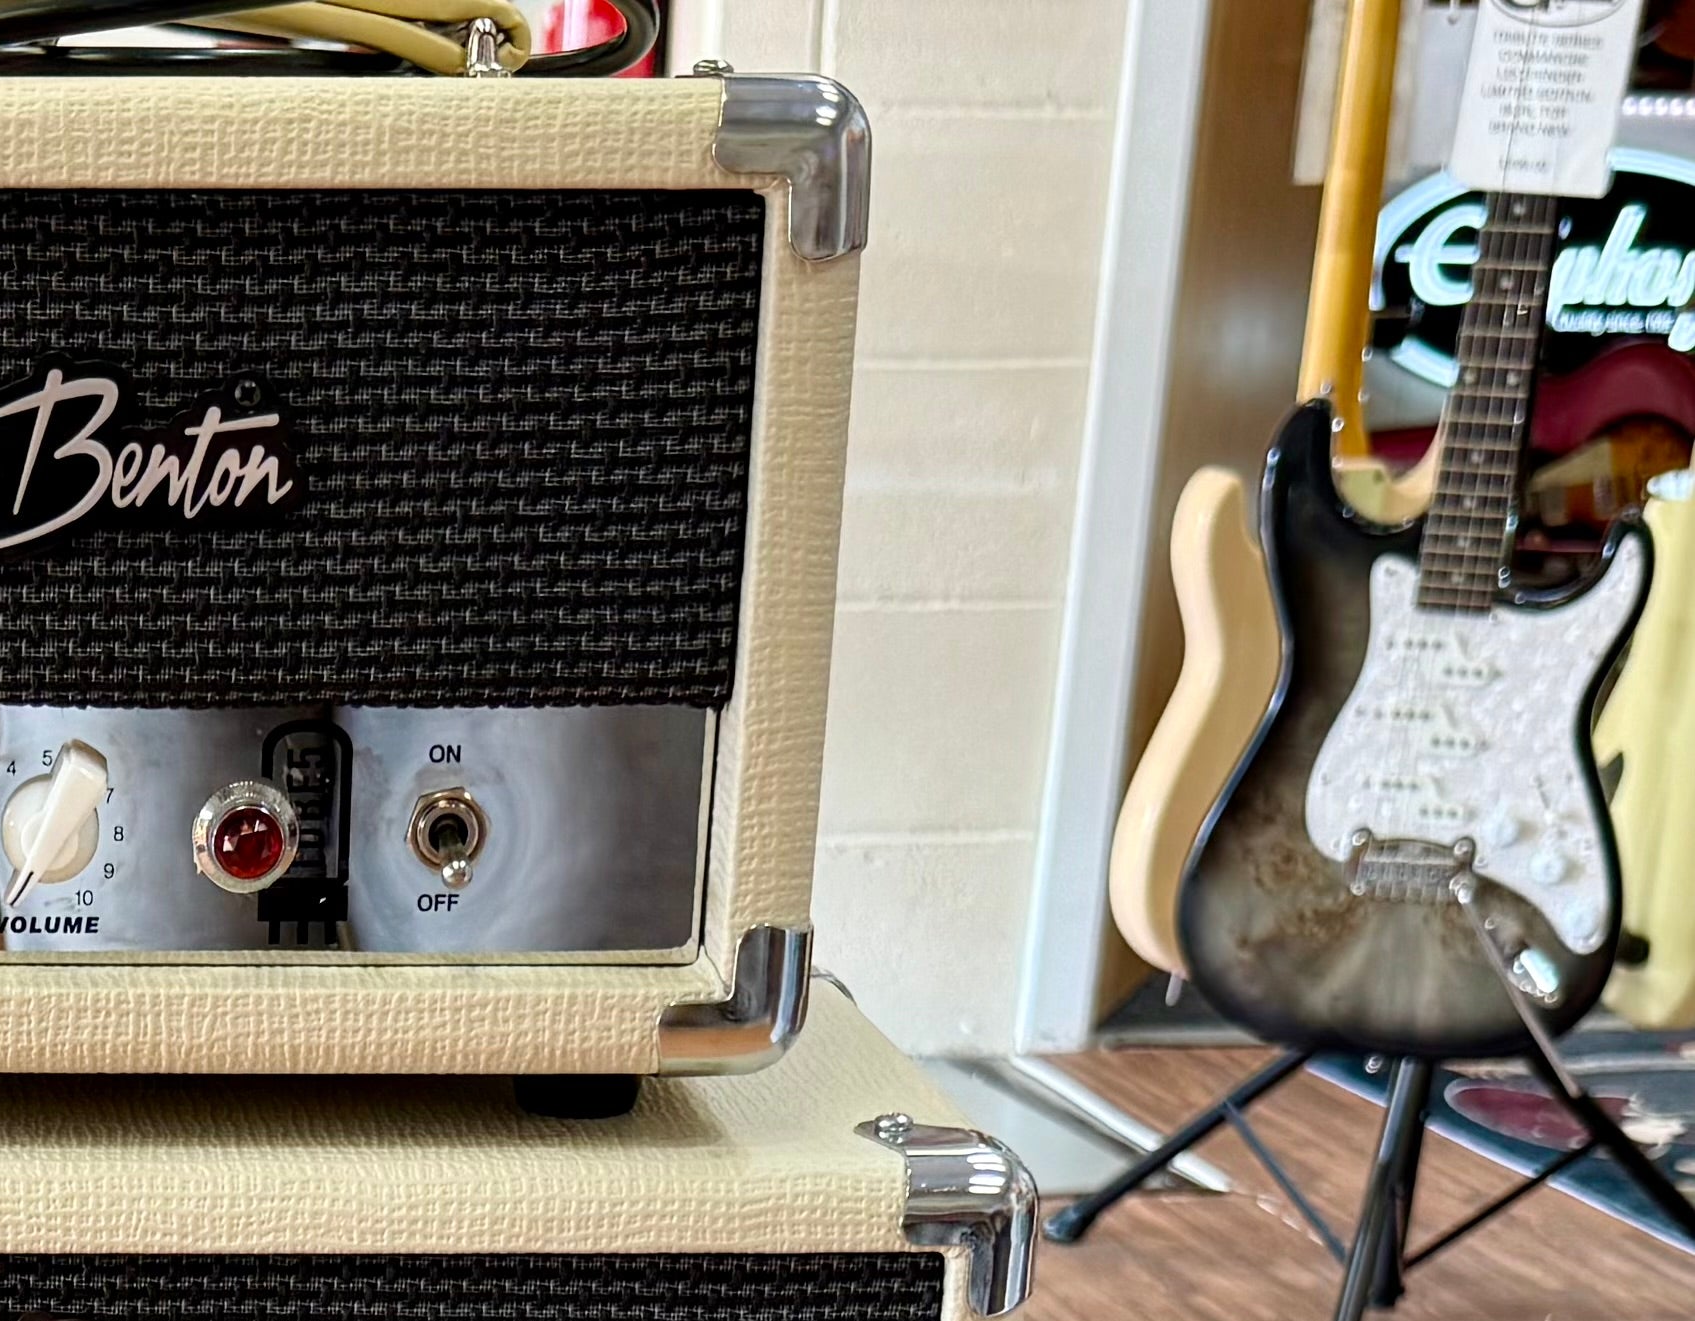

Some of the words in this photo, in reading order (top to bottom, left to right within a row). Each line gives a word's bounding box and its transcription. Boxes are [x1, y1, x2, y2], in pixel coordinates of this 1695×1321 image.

[42, 750, 53, 767] 5
[429, 745, 461, 763] ON
[6, 761, 17, 776] 4
[114, 826, 125, 841] 8
[104, 863, 115, 879] 9
[75, 890, 93, 906] 10
[417, 894, 459, 912] OFF
